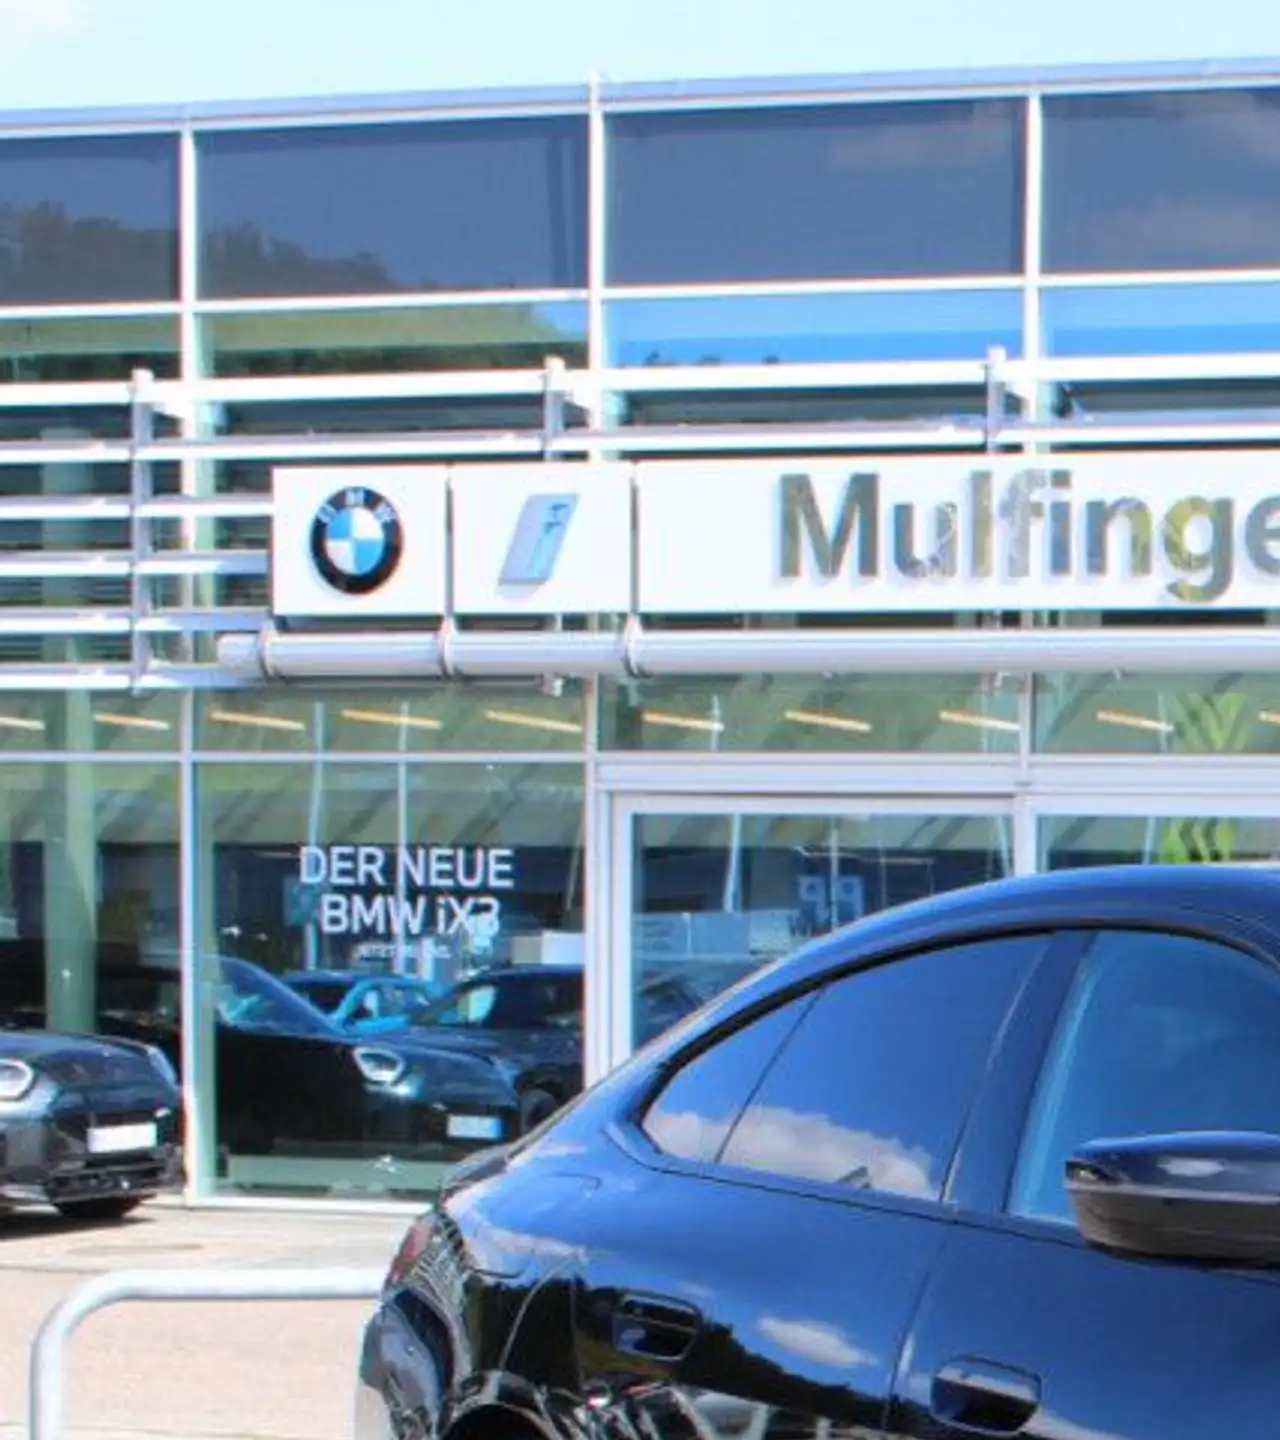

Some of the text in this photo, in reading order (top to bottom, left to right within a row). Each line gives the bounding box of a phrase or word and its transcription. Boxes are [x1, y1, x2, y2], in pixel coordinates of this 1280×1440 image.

[300, 846, 514, 889] DER NEUE
[320, 893, 425, 935] BMW
